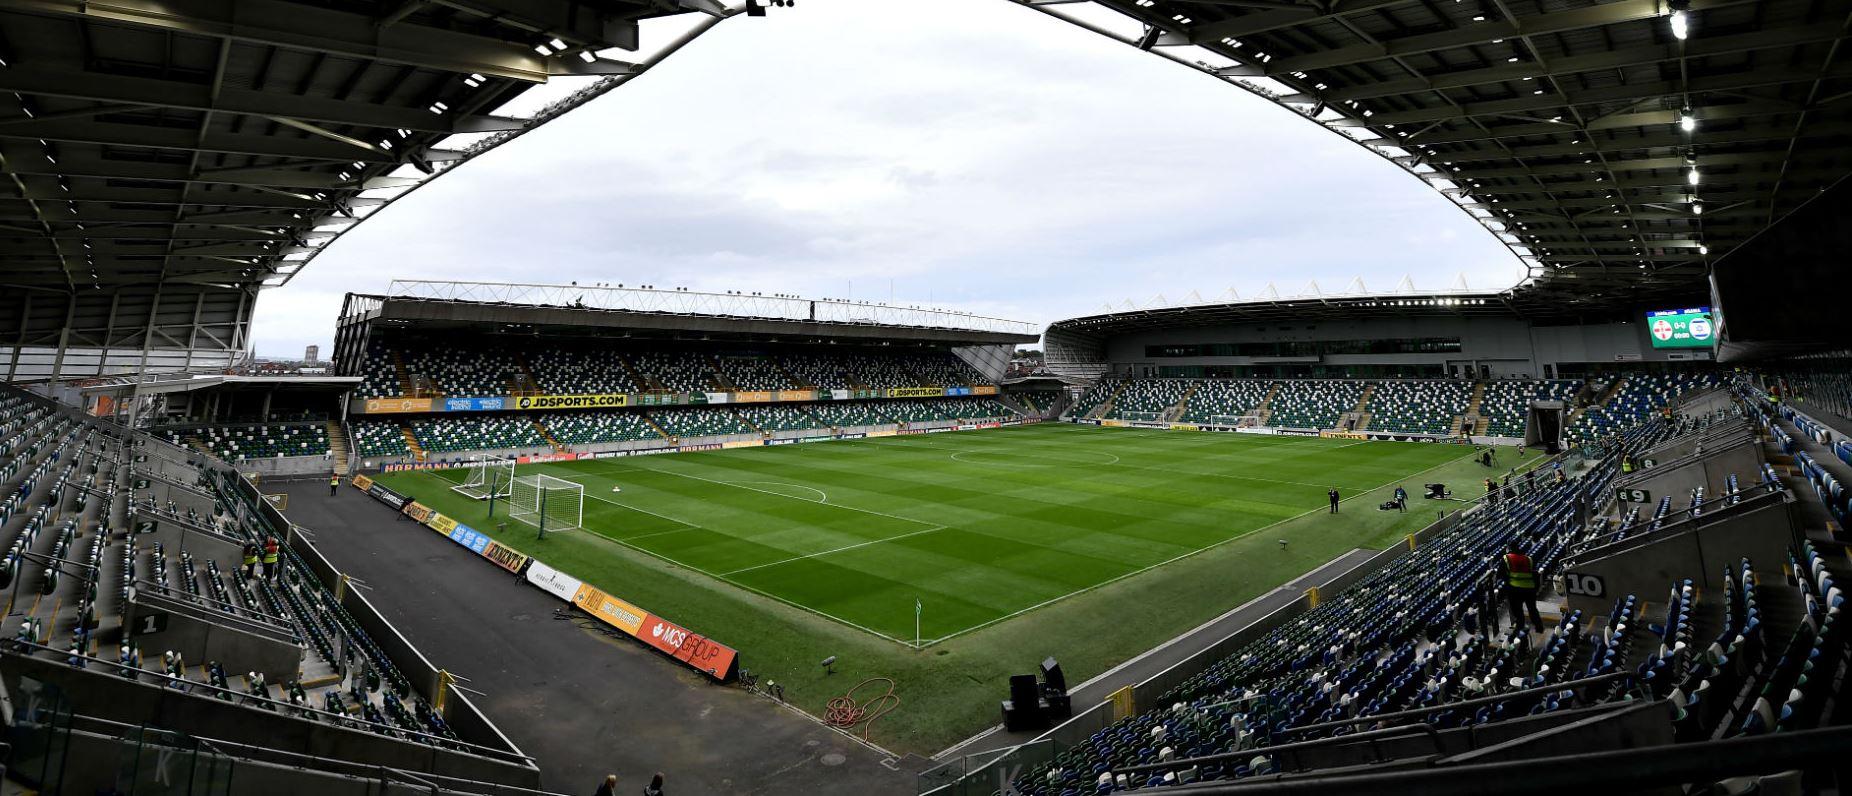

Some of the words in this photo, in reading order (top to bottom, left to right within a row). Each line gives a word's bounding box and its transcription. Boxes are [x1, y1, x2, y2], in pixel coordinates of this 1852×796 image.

[896, 389, 942, 397] JDSPORTS.COM
[533, 396, 624, 407] JDSPORTS.COM
[1644, 459, 1654, 468] 8
[138, 480, 147, 489] 3
[1631, 489, 1645, 502] 9
[140, 522, 153, 534] 2
[1567, 573, 1602, 597] 10
[143, 615, 157, 634] 1
[154, 748, 173, 787] K
